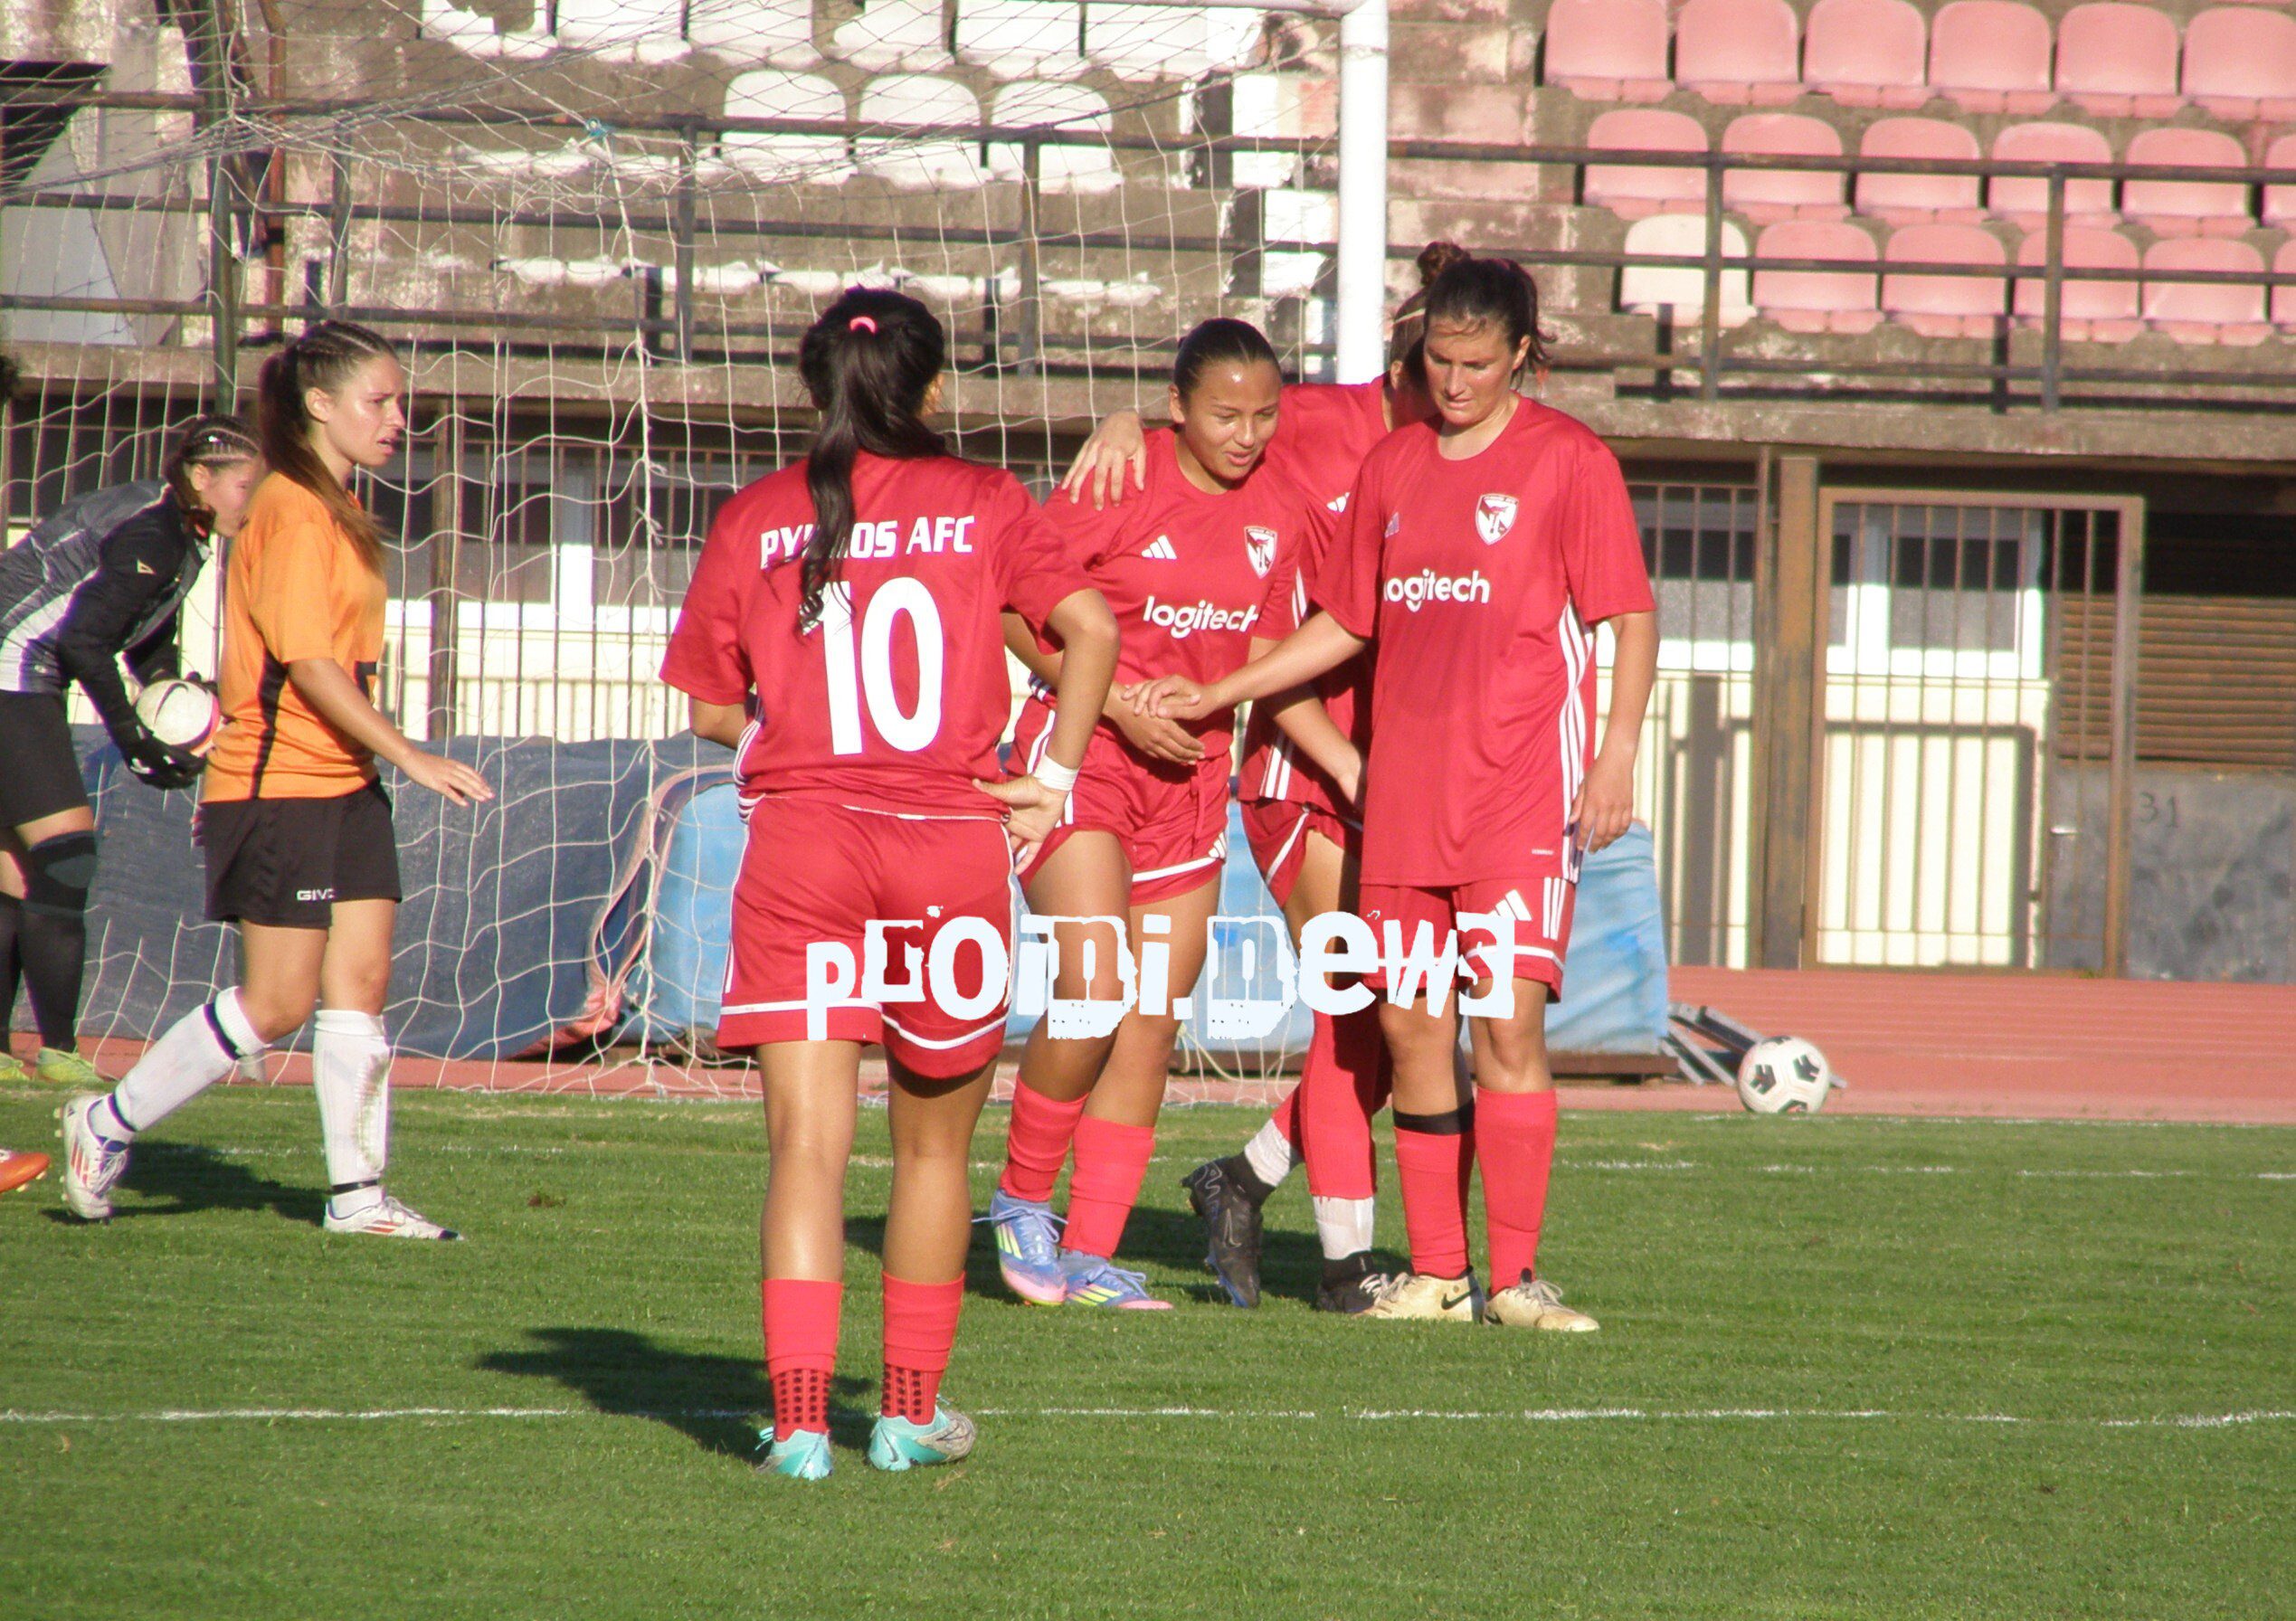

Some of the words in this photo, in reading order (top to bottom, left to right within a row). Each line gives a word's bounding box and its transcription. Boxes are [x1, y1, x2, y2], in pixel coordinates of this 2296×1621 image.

[760, 520, 898, 571] PYOS
[906, 515, 974, 555] AFC
[799, 576, 944, 755] 10
